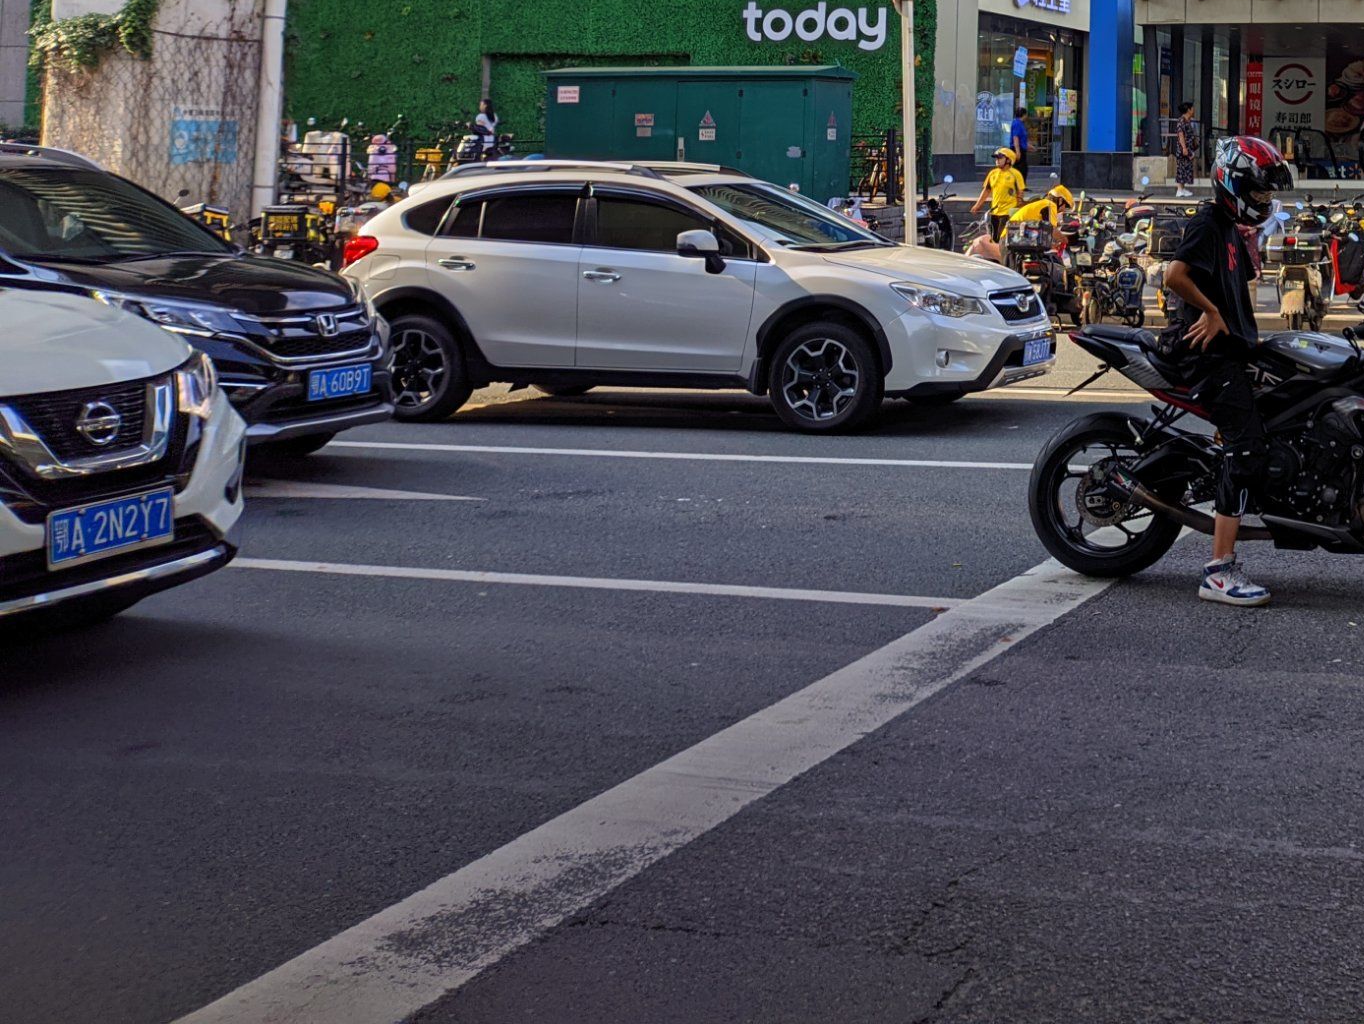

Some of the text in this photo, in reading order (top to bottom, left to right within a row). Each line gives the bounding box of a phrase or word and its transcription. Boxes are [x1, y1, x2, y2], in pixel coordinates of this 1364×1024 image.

[742, 1, 888, 52] today
[1272, 78, 1317, 89] スシロー
[1249, 82, 1262, 128] 眼镜店
[1275, 112, 1312, 124] 寿司郎
